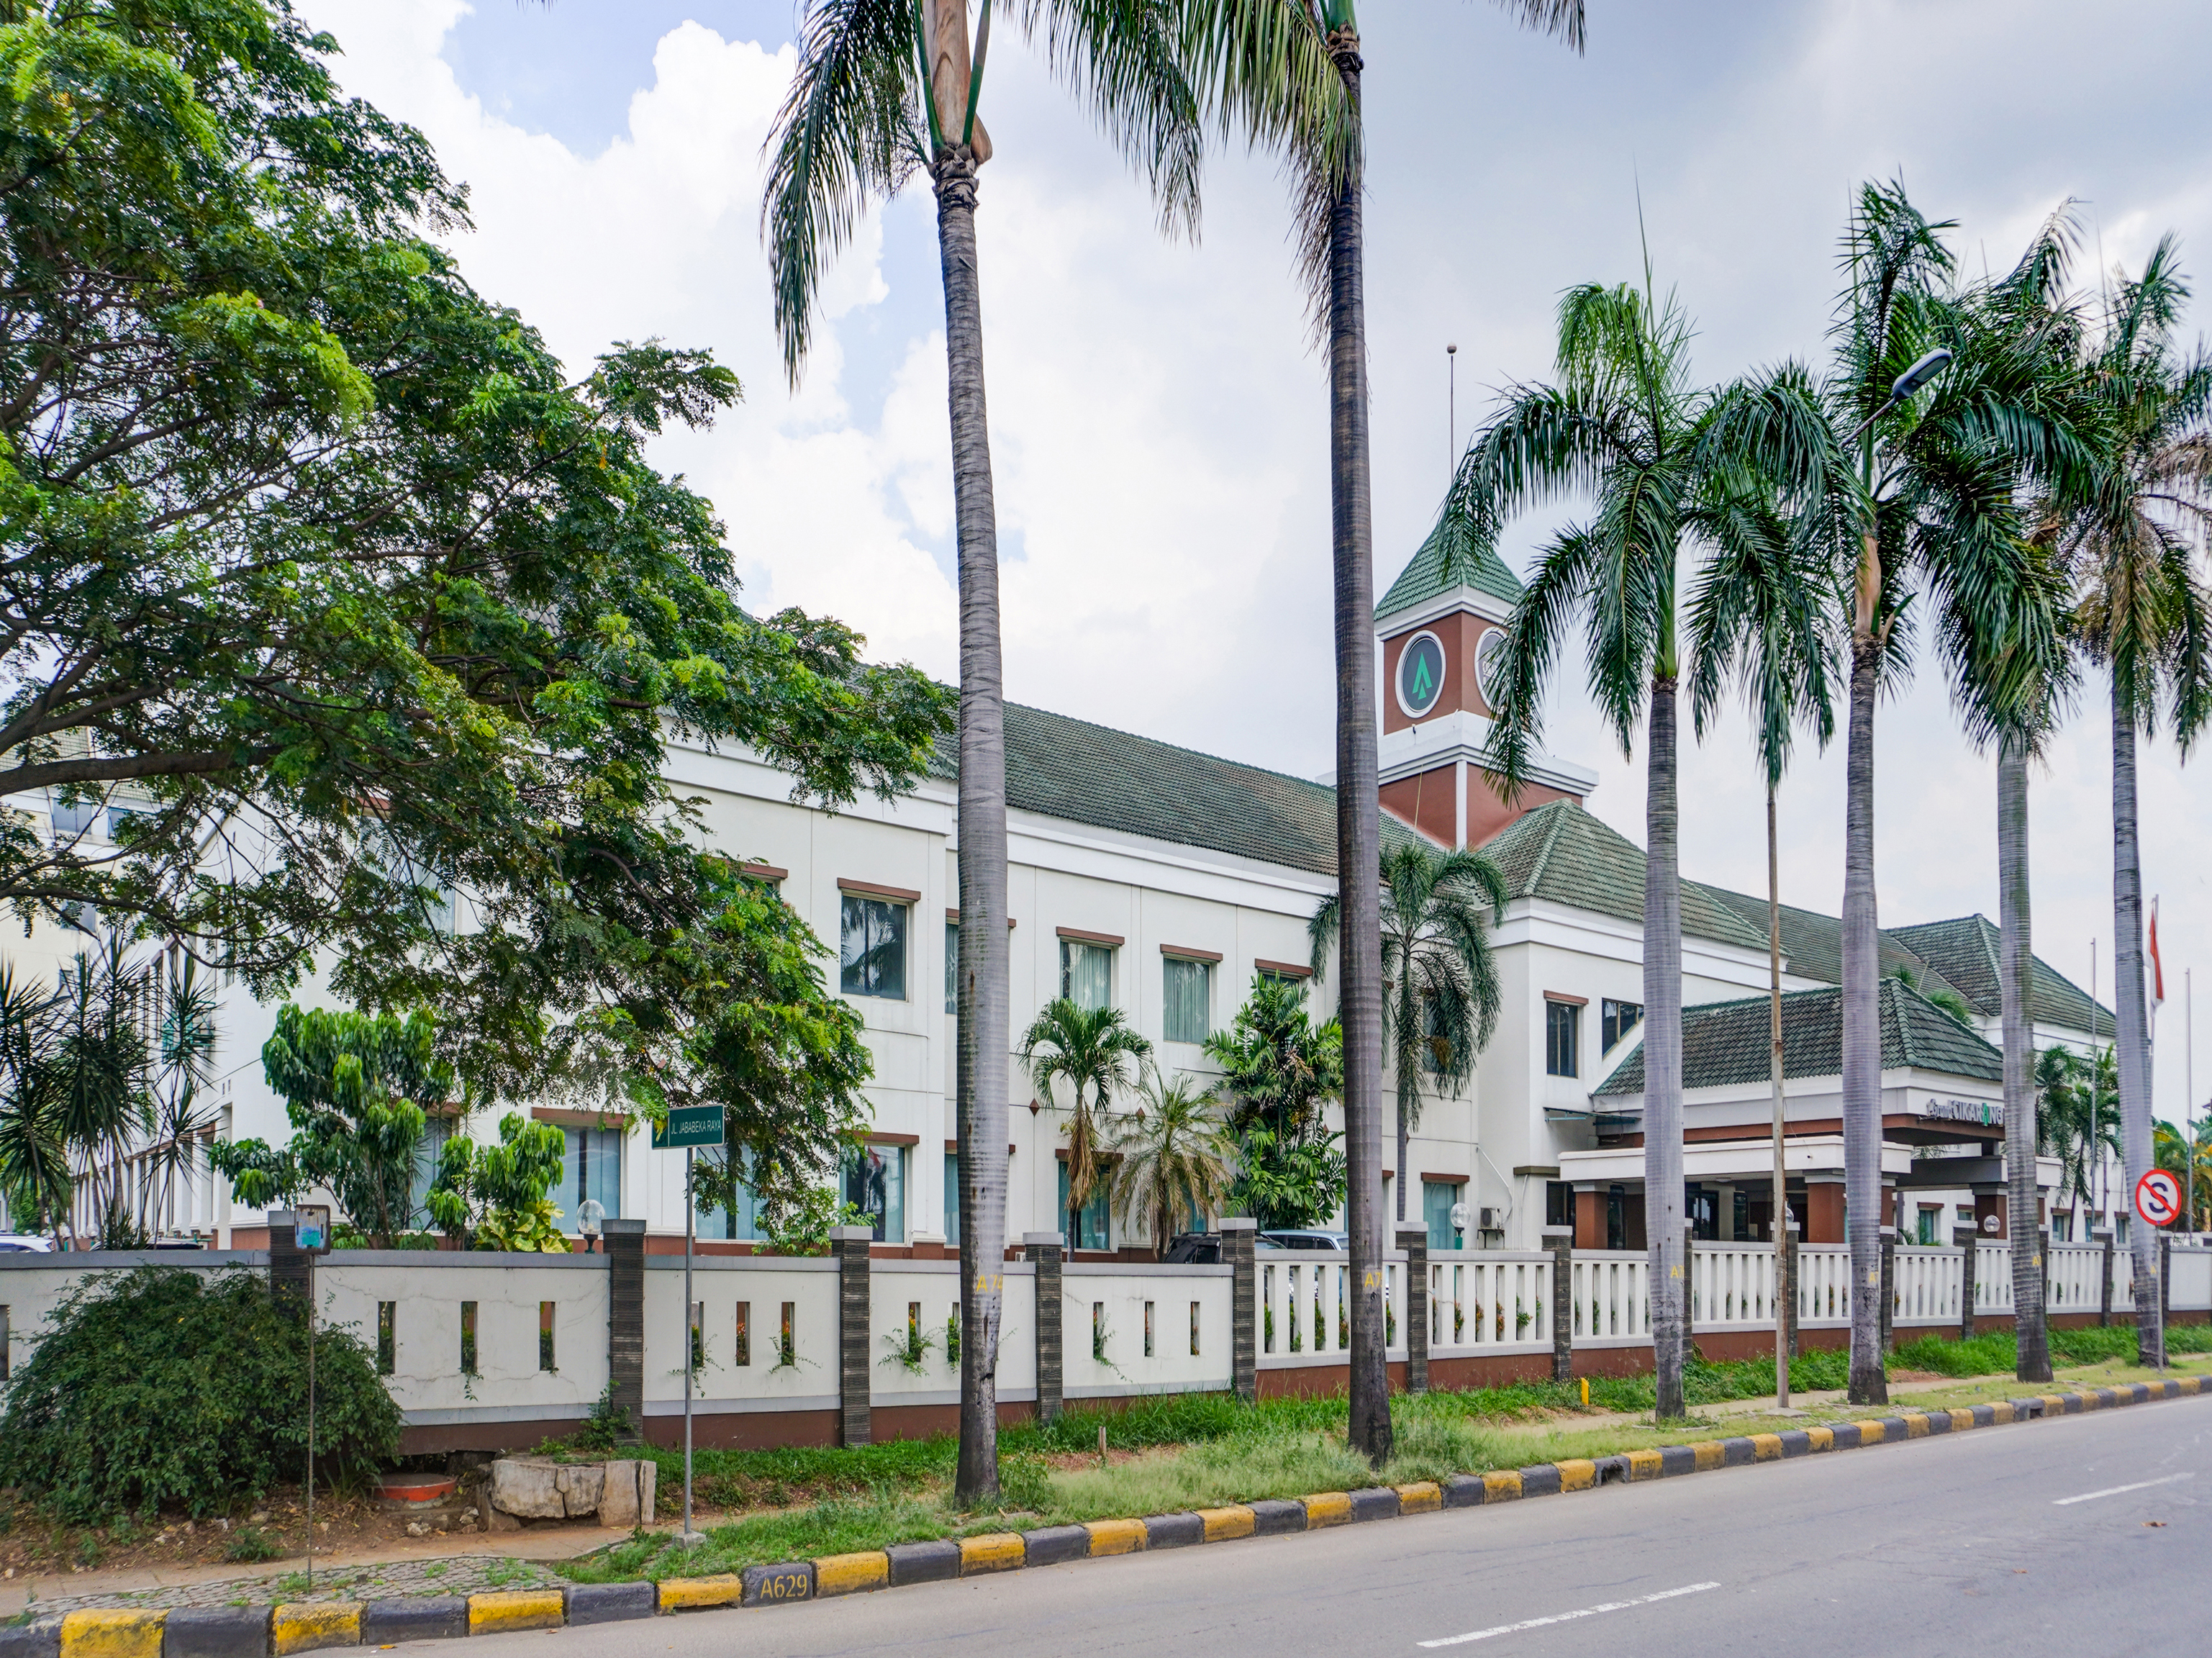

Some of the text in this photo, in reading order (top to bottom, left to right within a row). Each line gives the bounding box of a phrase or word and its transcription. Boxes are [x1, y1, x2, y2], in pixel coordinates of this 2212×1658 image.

[1952, 1100, 2003, 1125] CIKARANG
[679, 1120, 706, 1133] JABABEKA
[707, 1119, 722, 1132] RAYA
[2149, 1182, 2168, 1213] S
[1364, 1272, 1382, 1287] A7
[1670, 1264, 1685, 1279] A7
[760, 1574, 807, 1599] A629
